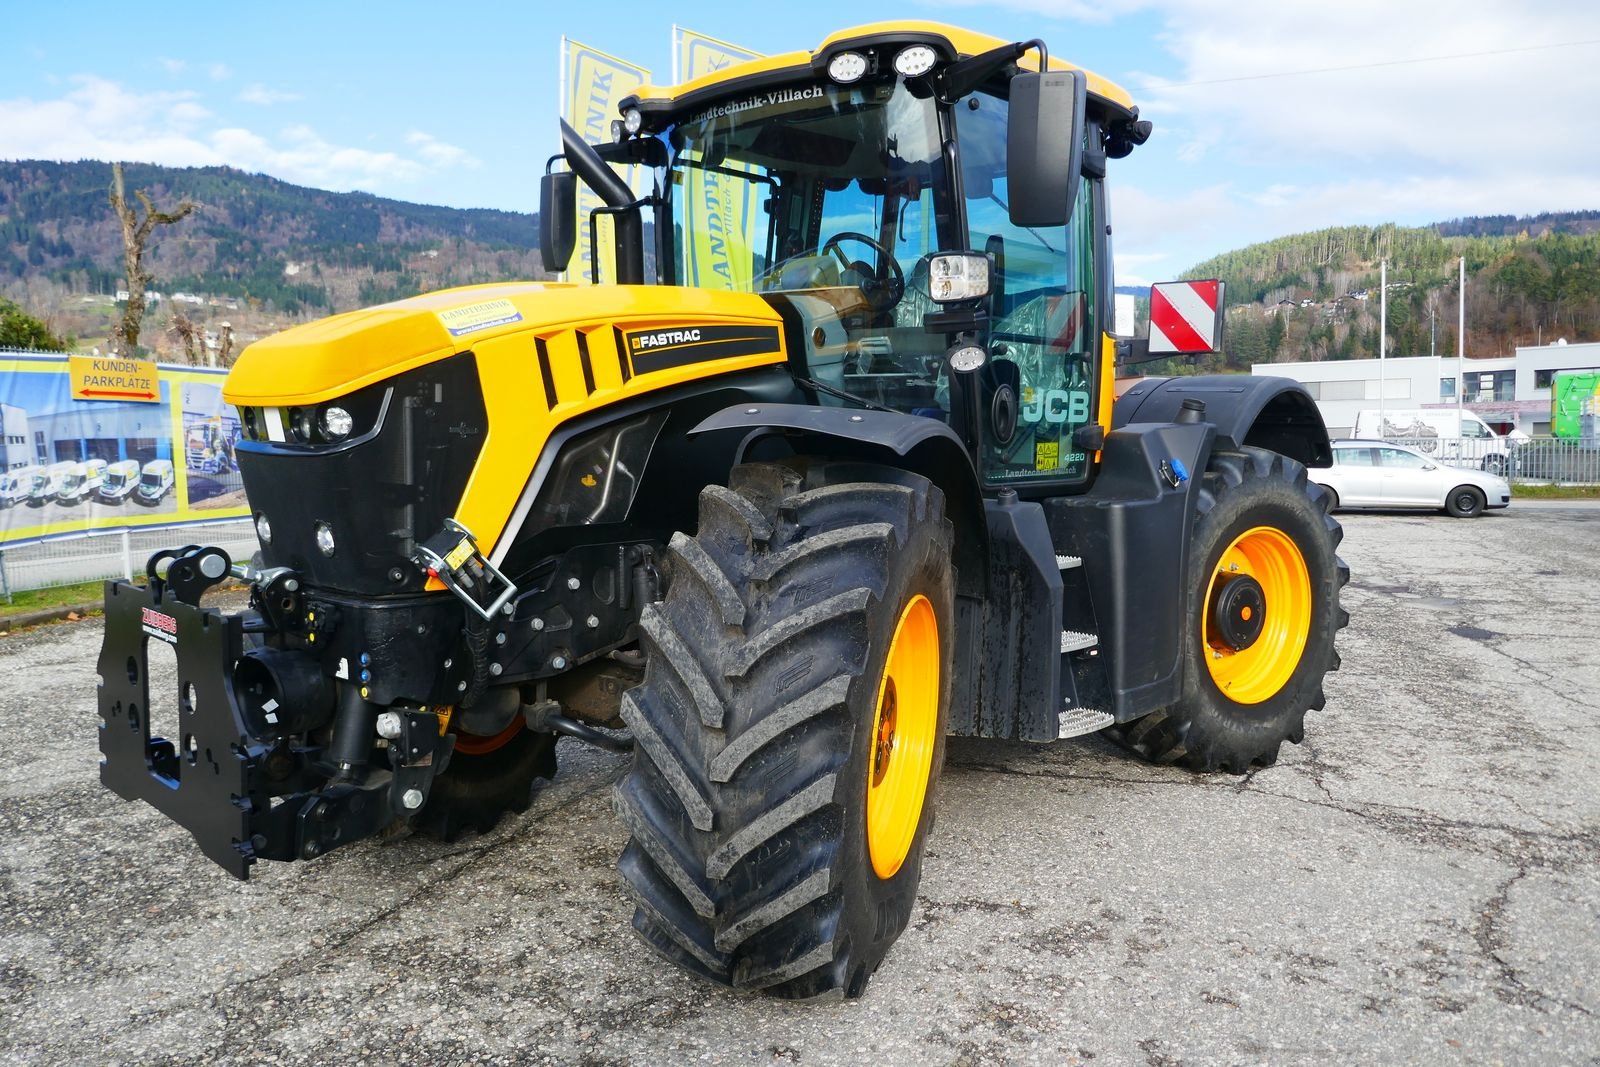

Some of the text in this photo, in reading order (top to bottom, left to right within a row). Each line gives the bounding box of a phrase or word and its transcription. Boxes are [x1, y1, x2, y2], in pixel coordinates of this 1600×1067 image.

[690, 85, 823, 125] Landtechnik-Villach
[640, 329, 701, 348] FASTRAC
[92, 360, 142, 373] KUNDEN-
[83, 374, 151, 389] PARKPLÄTZE
[1023, 389, 1089, 423] JCB
[1064, 453, 1085, 462] 4220
[142, 607, 178, 634] ZUIDBERG
